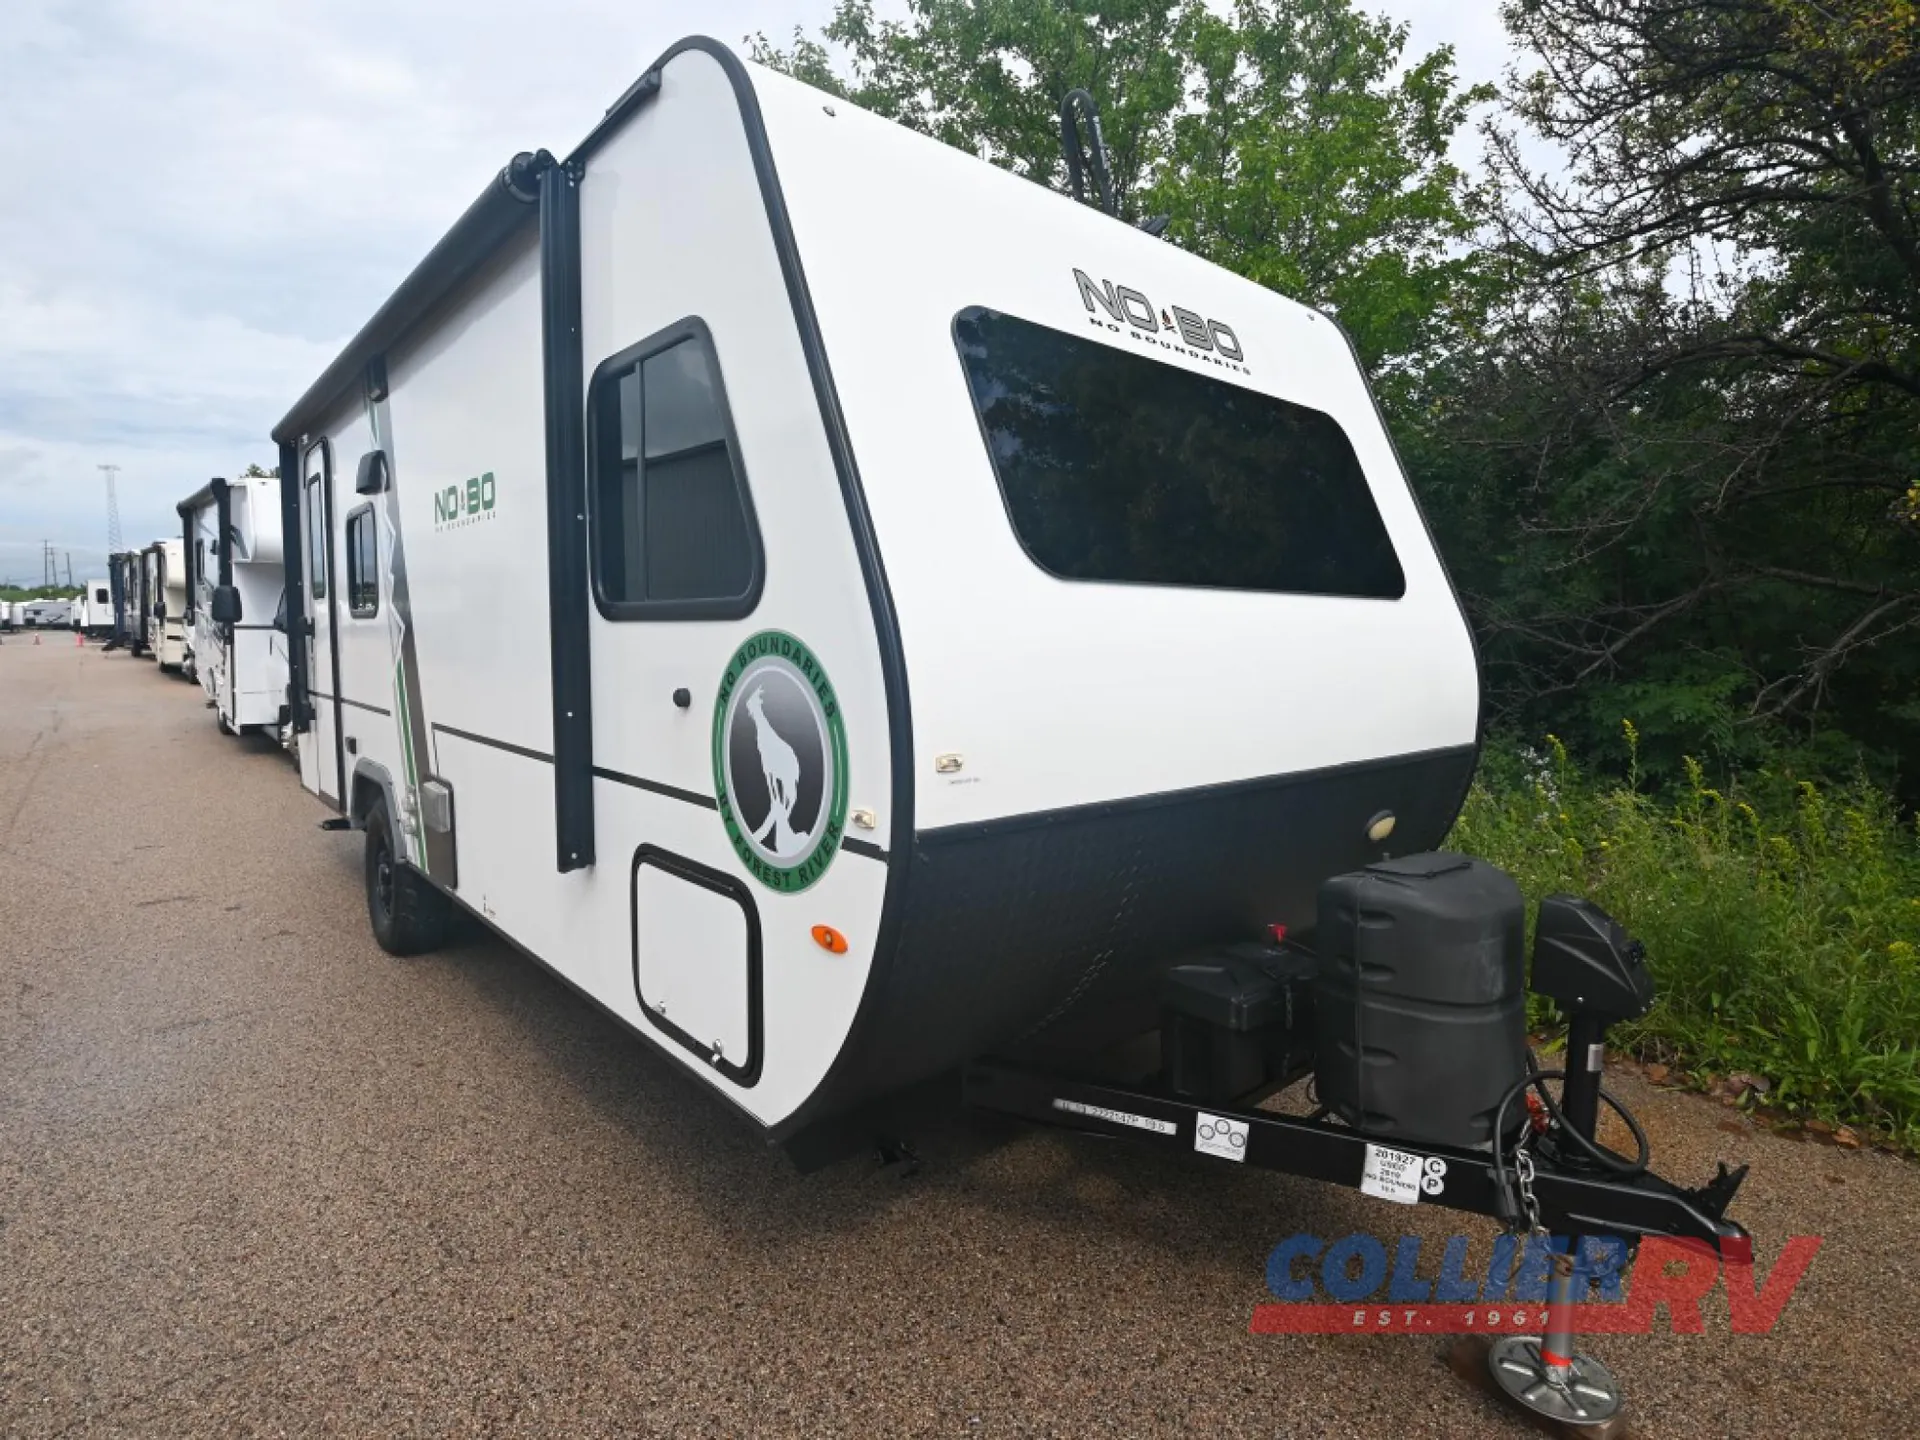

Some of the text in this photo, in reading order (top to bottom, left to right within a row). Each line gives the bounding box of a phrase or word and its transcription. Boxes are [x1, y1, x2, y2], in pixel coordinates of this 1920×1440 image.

[1089, 317, 1251, 375] NO BOUNDARIES
[720, 636, 836, 718] NO BOUNDARIES
[734, 833, 791, 888] FOREST
[798, 818, 841, 884] RIVER
[1426, 1178, 1439, 1190] P
[1429, 1160, 1441, 1173] C
